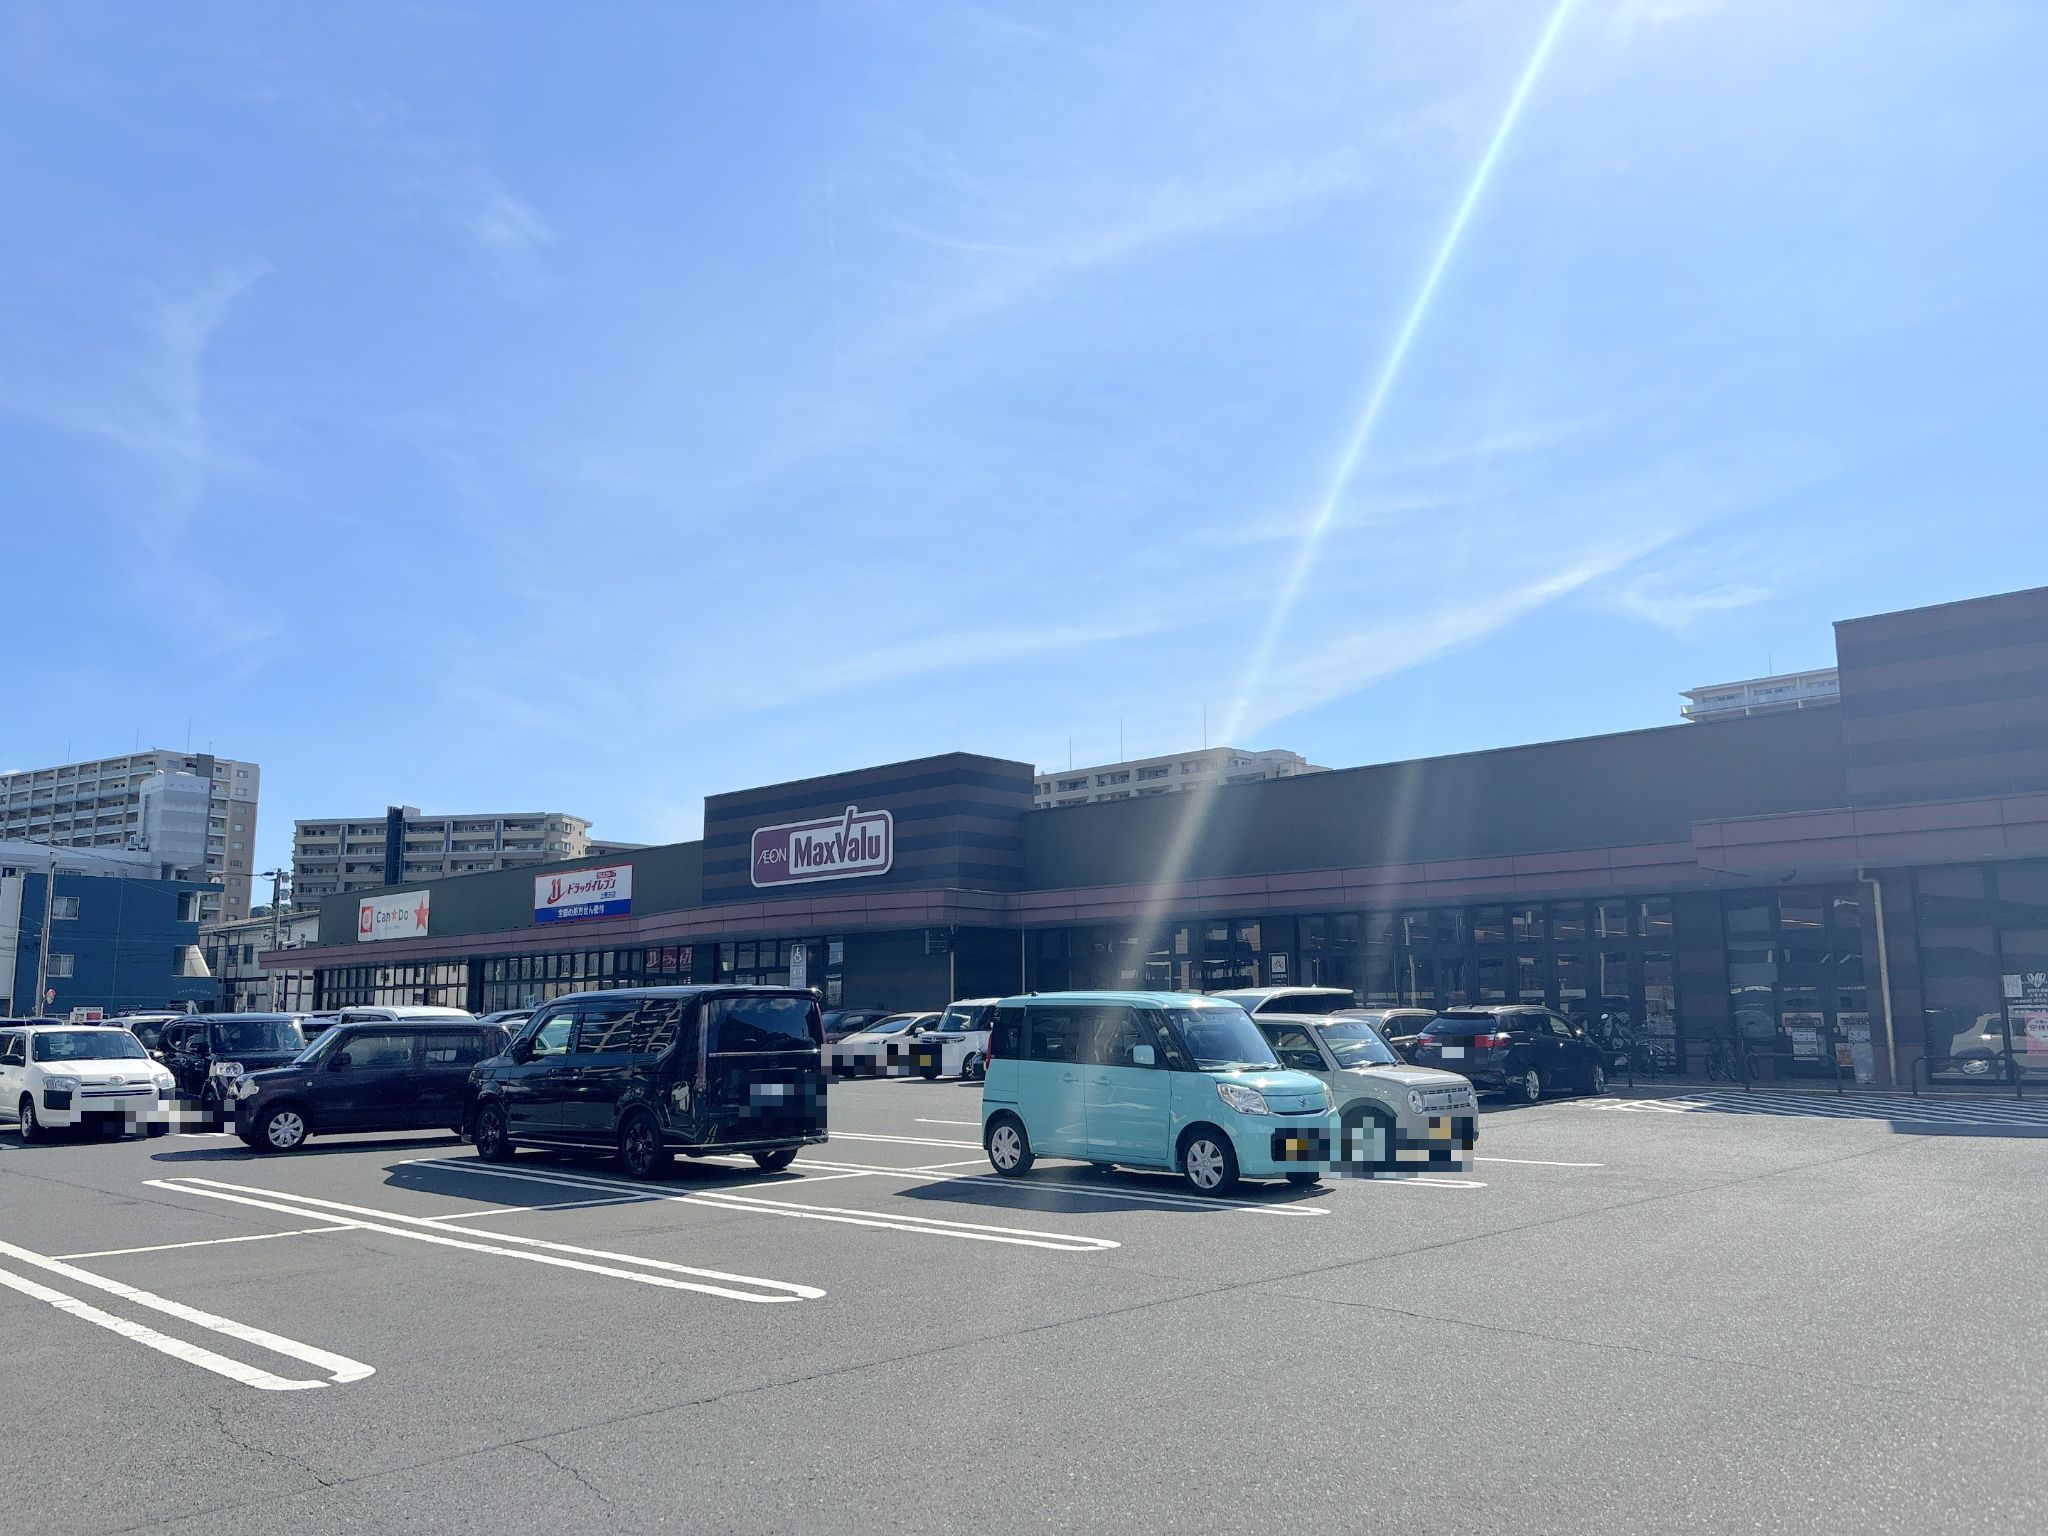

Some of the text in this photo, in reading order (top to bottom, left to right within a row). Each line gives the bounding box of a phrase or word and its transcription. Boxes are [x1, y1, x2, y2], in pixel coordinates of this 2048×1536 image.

[794, 810, 881, 868] MaxValu
[567, 877, 616, 894] ドラッグイレブン
